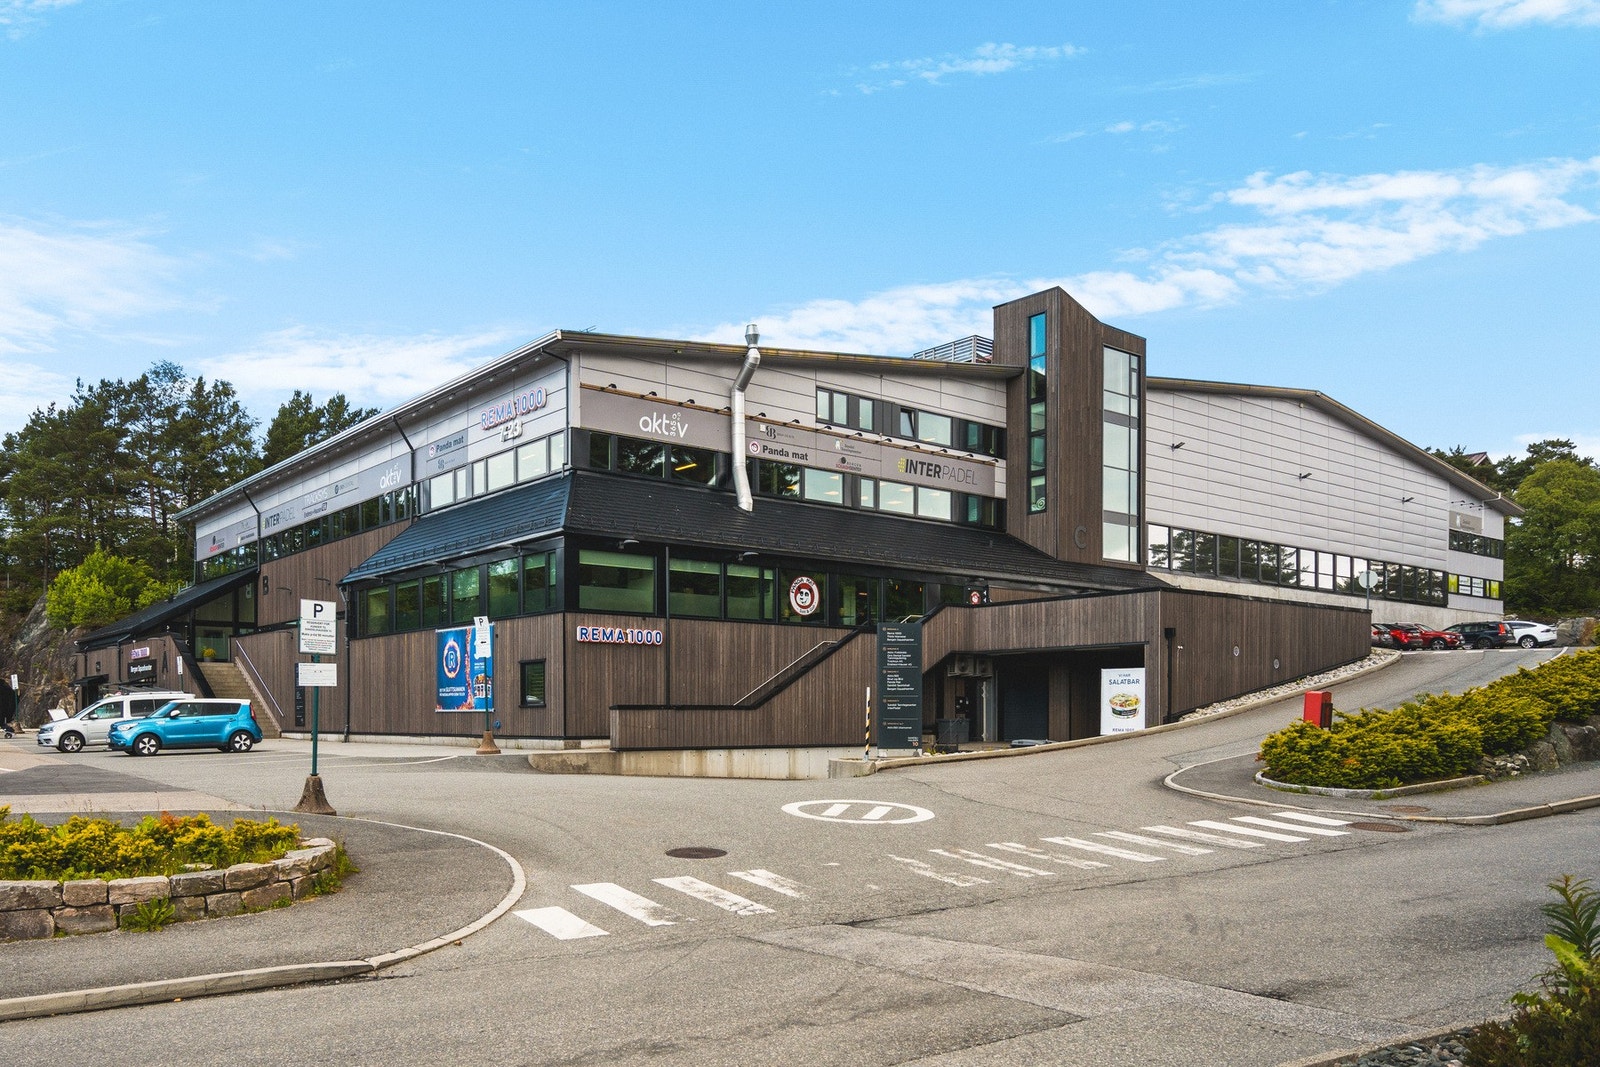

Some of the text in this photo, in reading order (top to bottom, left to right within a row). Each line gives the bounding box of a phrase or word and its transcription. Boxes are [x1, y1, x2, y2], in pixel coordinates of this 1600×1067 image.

[481, 388, 546, 430] REMA 1000
[436, 436, 464, 453] Panda mat
[762, 445, 808, 461] Panda mat
[1074, 526, 1087, 549] C
[263, 575, 269, 595] B
[791, 578, 804, 593] PANDA
[313, 603, 324, 618] P
[577, 626, 662, 645] REMA 1000
